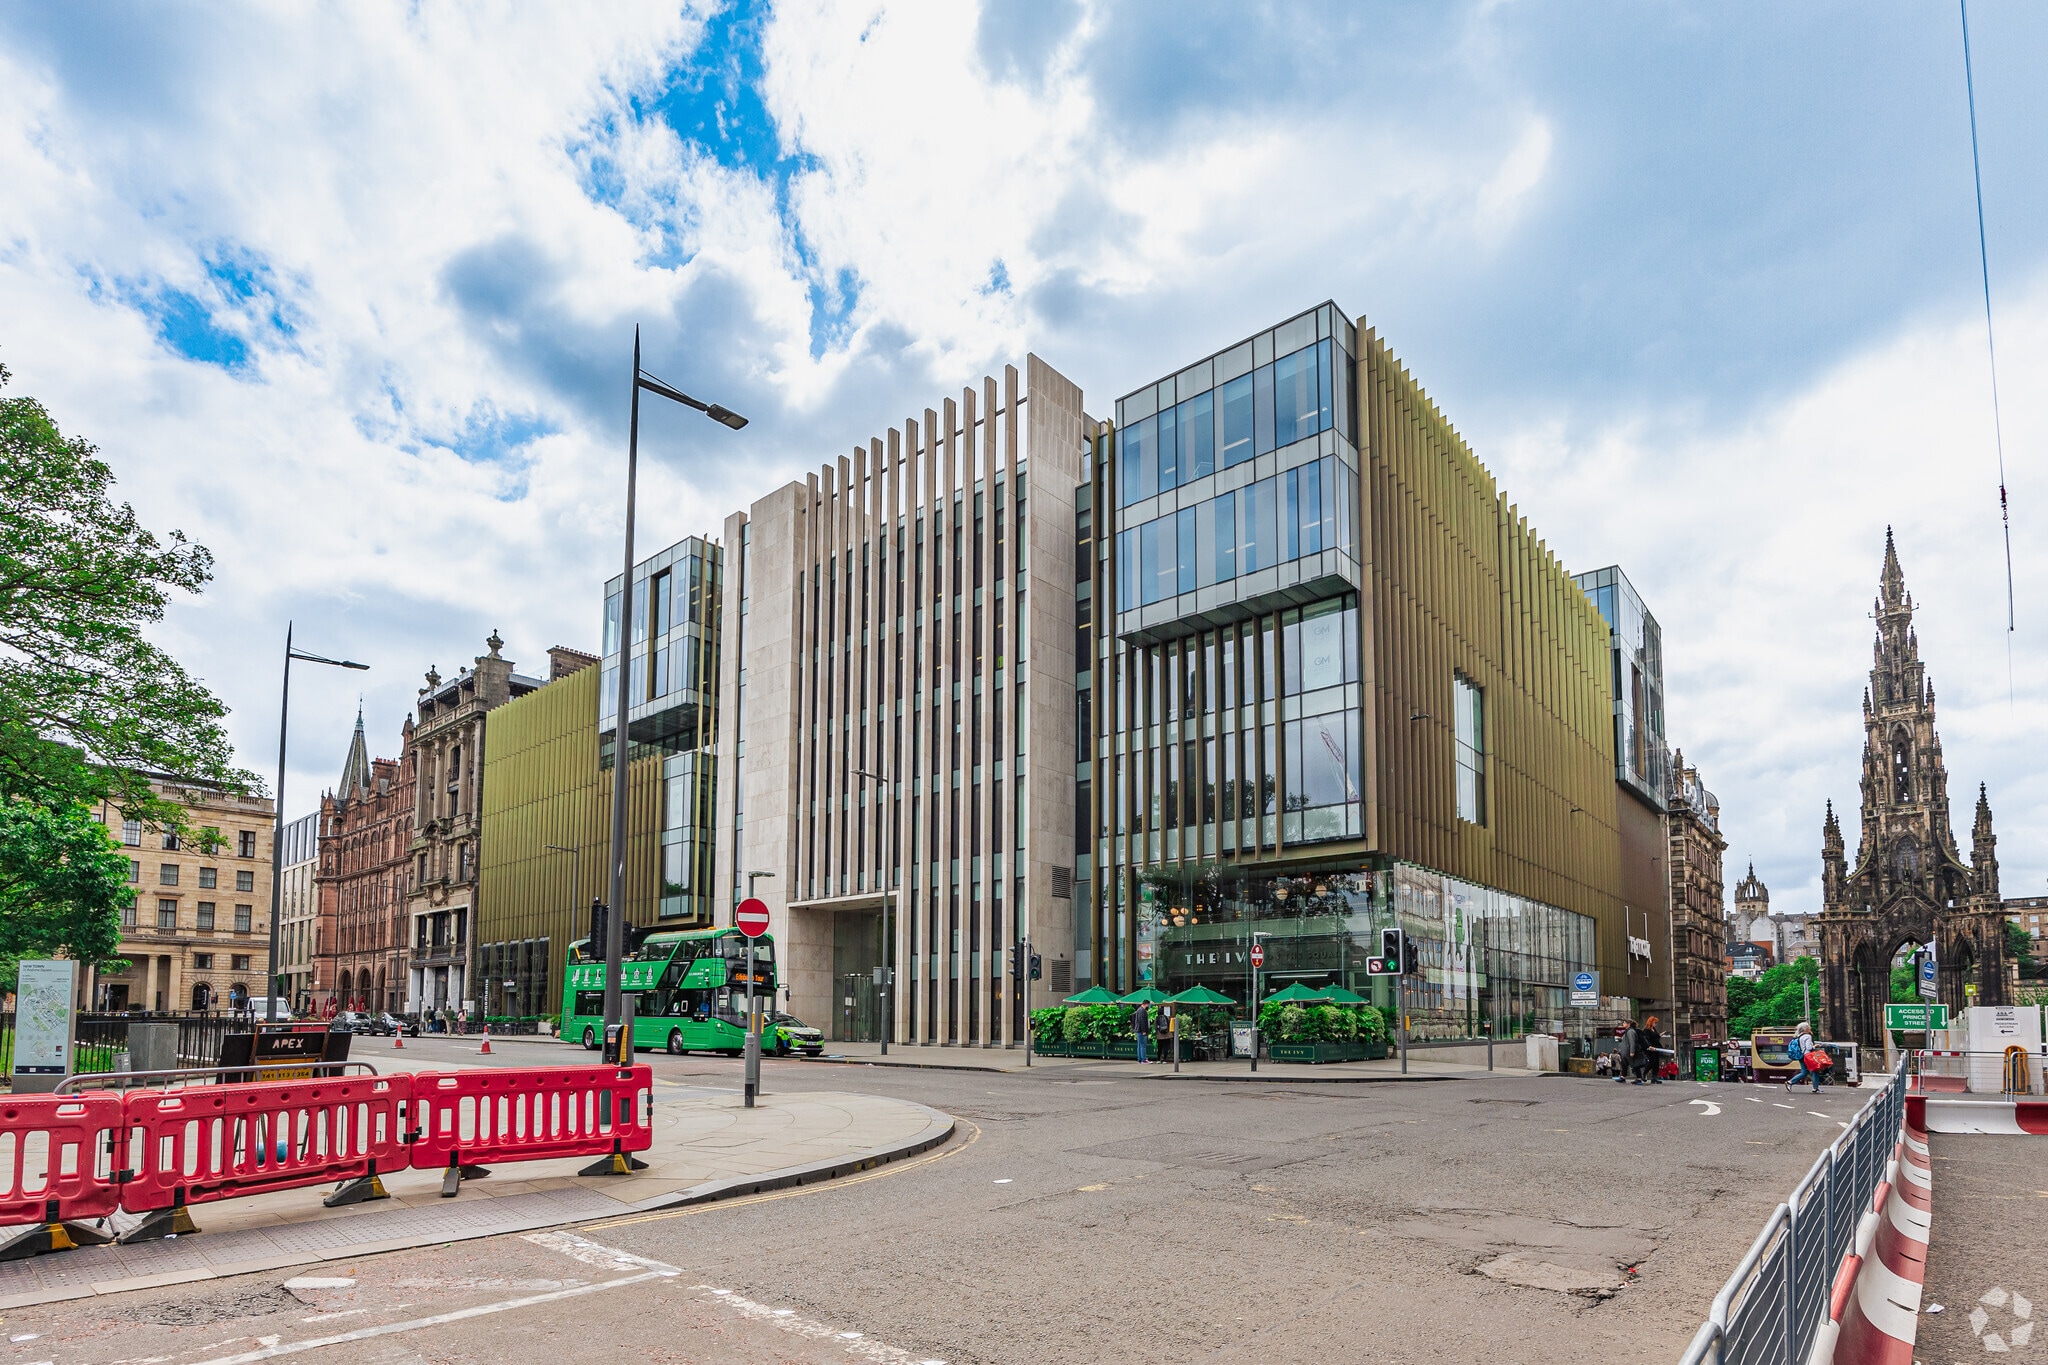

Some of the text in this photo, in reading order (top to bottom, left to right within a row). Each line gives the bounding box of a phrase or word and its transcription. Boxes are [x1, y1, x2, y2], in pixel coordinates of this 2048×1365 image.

[1184, 953, 1216, 965] THE
[1225, 952, 1247, 964] IV
[272, 1039, 304, 1049] APEX
